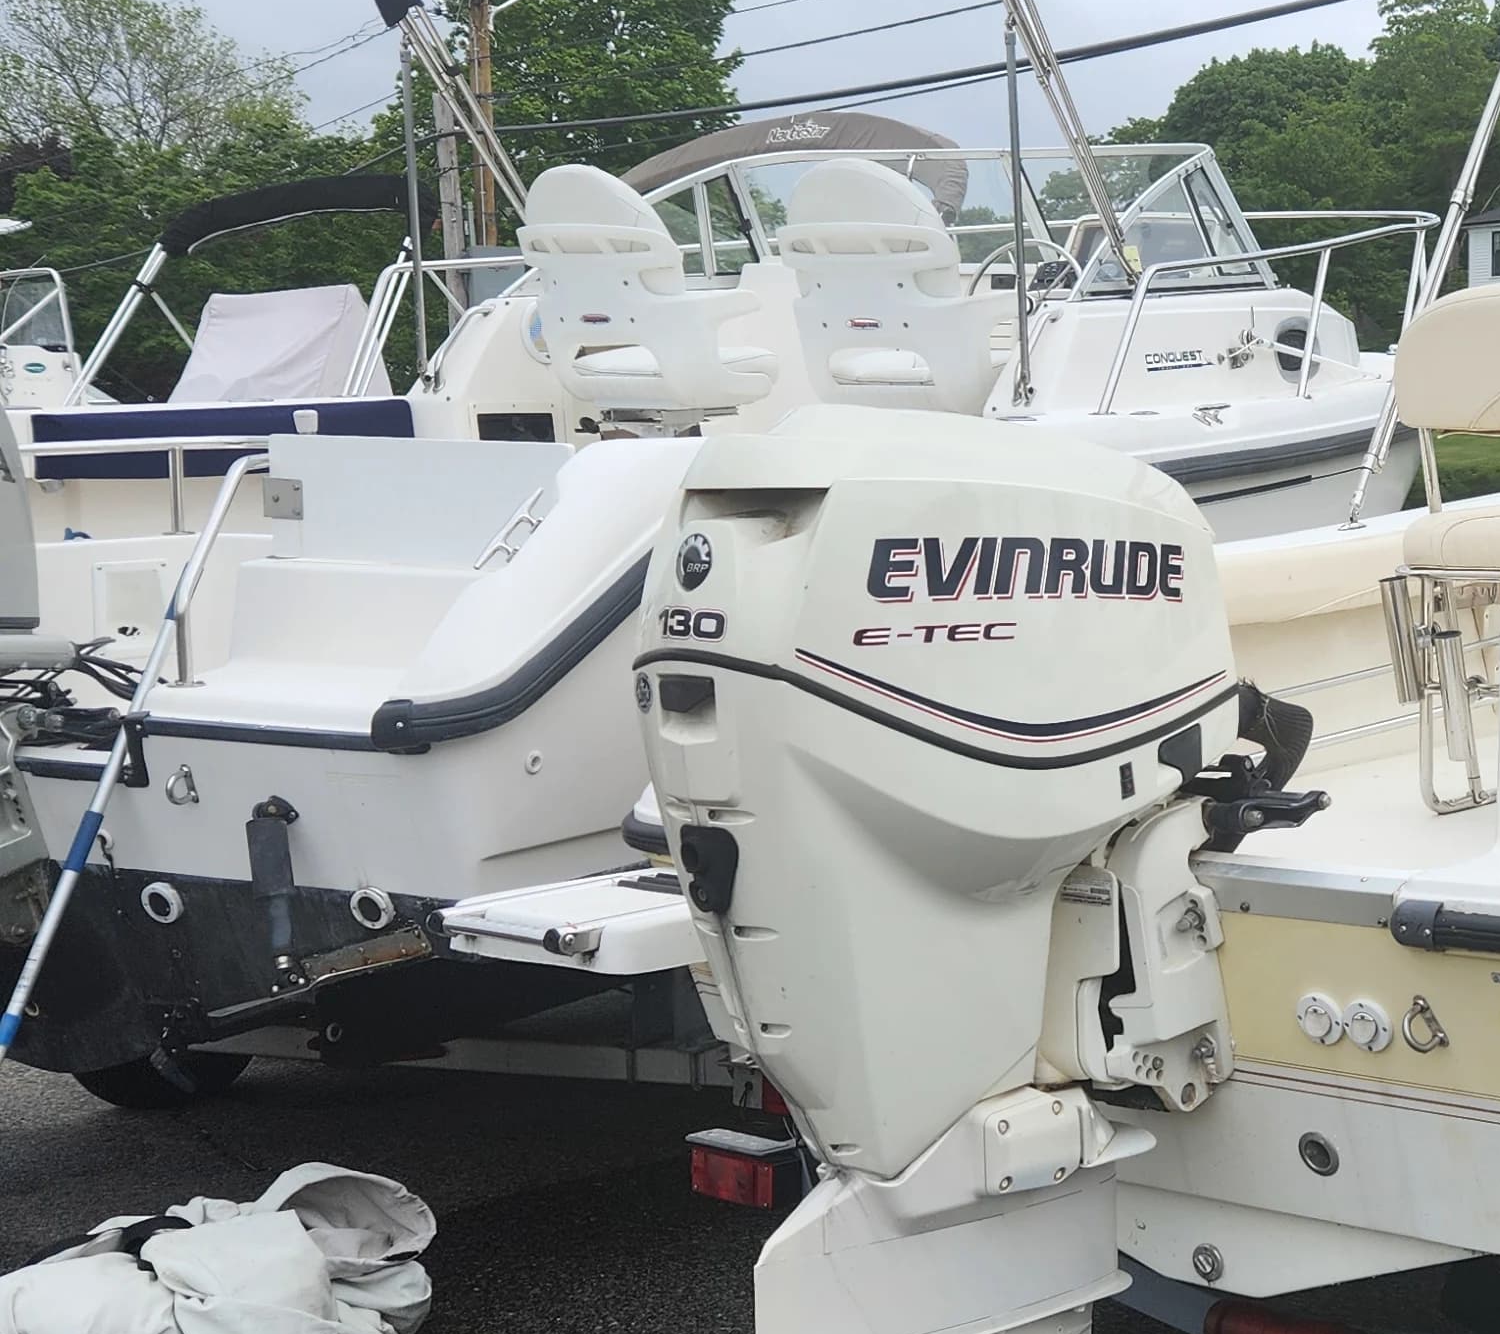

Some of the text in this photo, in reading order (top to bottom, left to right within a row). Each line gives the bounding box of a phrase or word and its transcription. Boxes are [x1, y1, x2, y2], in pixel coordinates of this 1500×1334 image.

[1144, 349, 1203, 365] CONQUEST
[686, 562, 709, 573] BRP
[867, 537, 1184, 602] EVINRUDE
[658, 605, 728, 643] 130
[852, 621, 1018, 646] E-TEC
